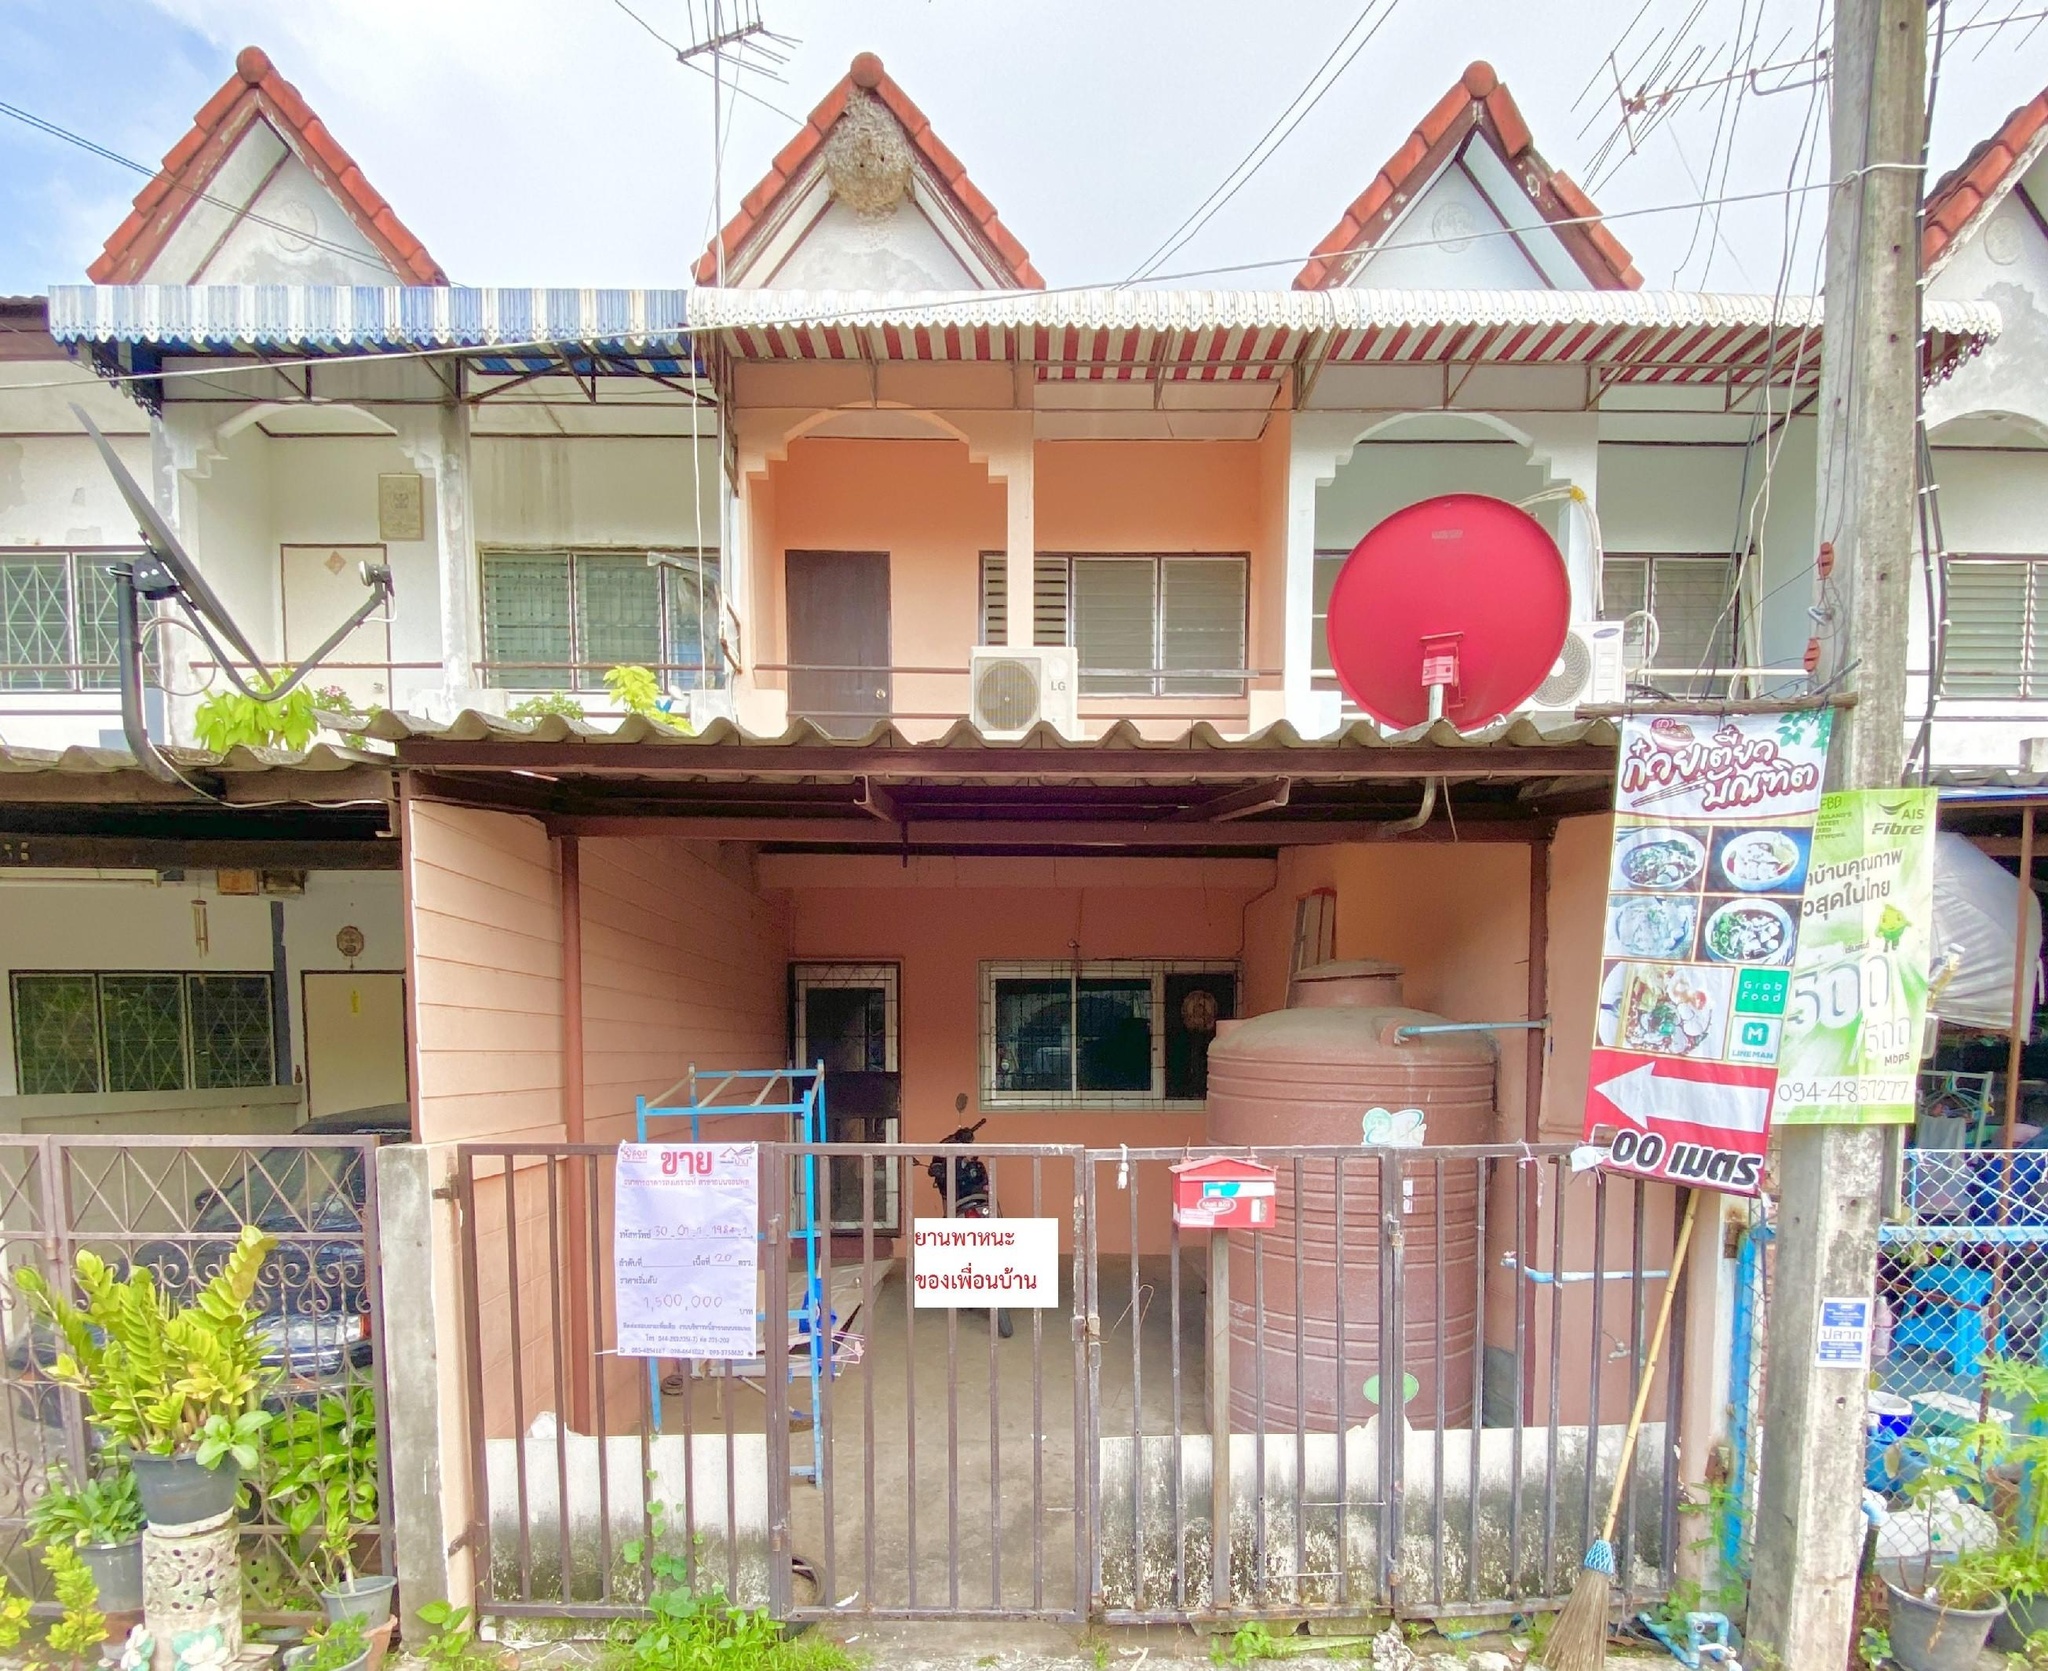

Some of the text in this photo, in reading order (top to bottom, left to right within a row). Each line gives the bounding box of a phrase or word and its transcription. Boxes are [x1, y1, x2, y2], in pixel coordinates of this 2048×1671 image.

[1050, 681, 1067, 691] LG
[1901, 808, 1925, 820] AIS
[1871, 822, 1925, 835] Fibre
[1807, 849, 1904, 887] งบ้านคุณภาพ
[1802, 877, 1891, 920] วสุดในไทย
[1743, 980, 1783, 991] Grab
[1741, 991, 1781, 1002] Food
[1884, 1052, 1910, 1066] Mbps
[661, 1151, 712, 1175] ขาย
[1612, 1131, 1762, 1186] 00 เมตร
[739, 1307, 754, 1316] บาท
